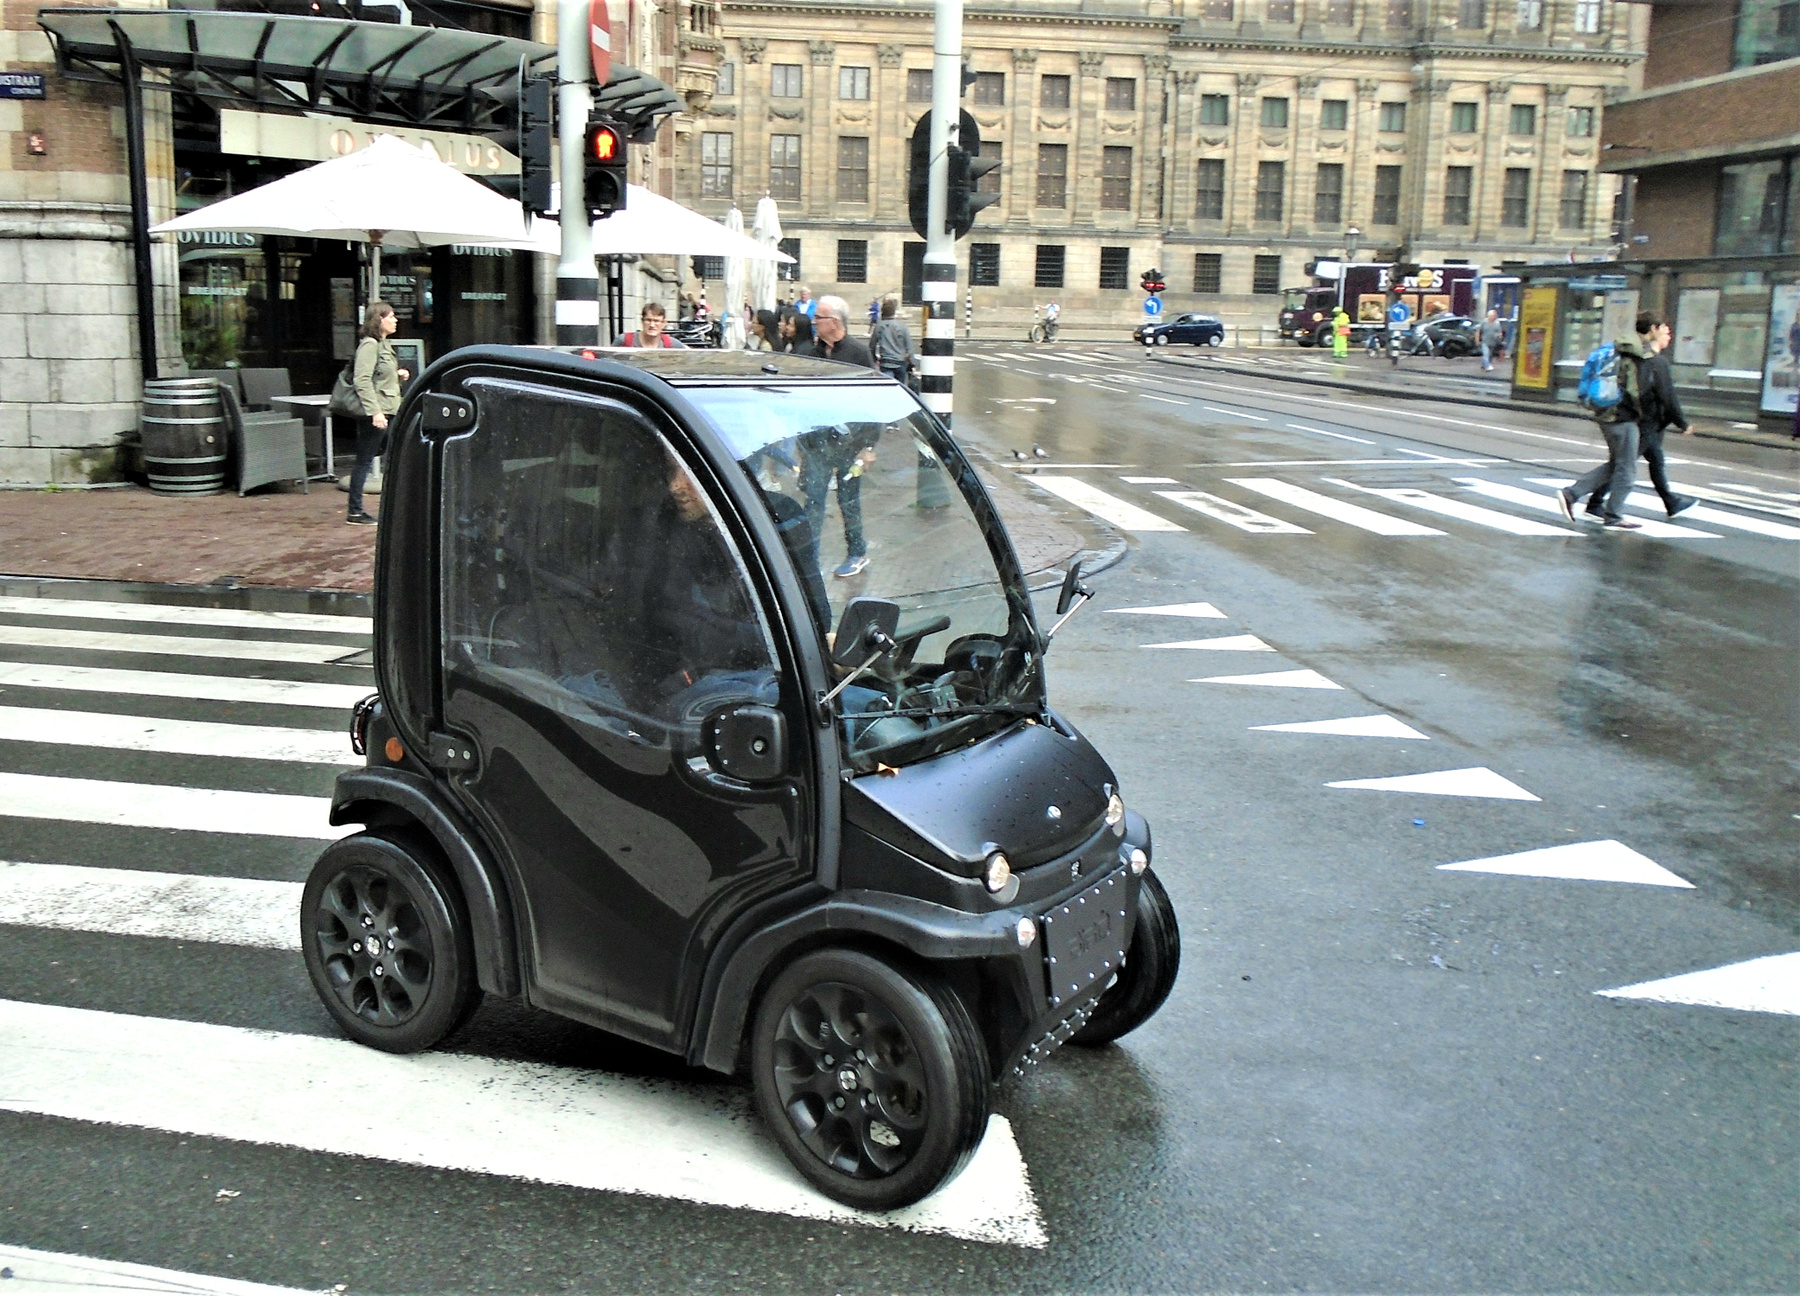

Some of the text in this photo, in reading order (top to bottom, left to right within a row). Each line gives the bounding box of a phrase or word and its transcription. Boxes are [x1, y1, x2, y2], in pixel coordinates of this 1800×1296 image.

[0, 75, 41, 86] ISTRAAT
[329, 128, 502, 170] ODIUS
[177, 231, 255, 246] OVIDIUS
[379, 275, 417, 285] VIDIUS
[1378, 269, 1444, 288] HNOS
[188, 286, 248, 296] BREAKFAST
[461, 292, 507, 300] BREAKFAST
